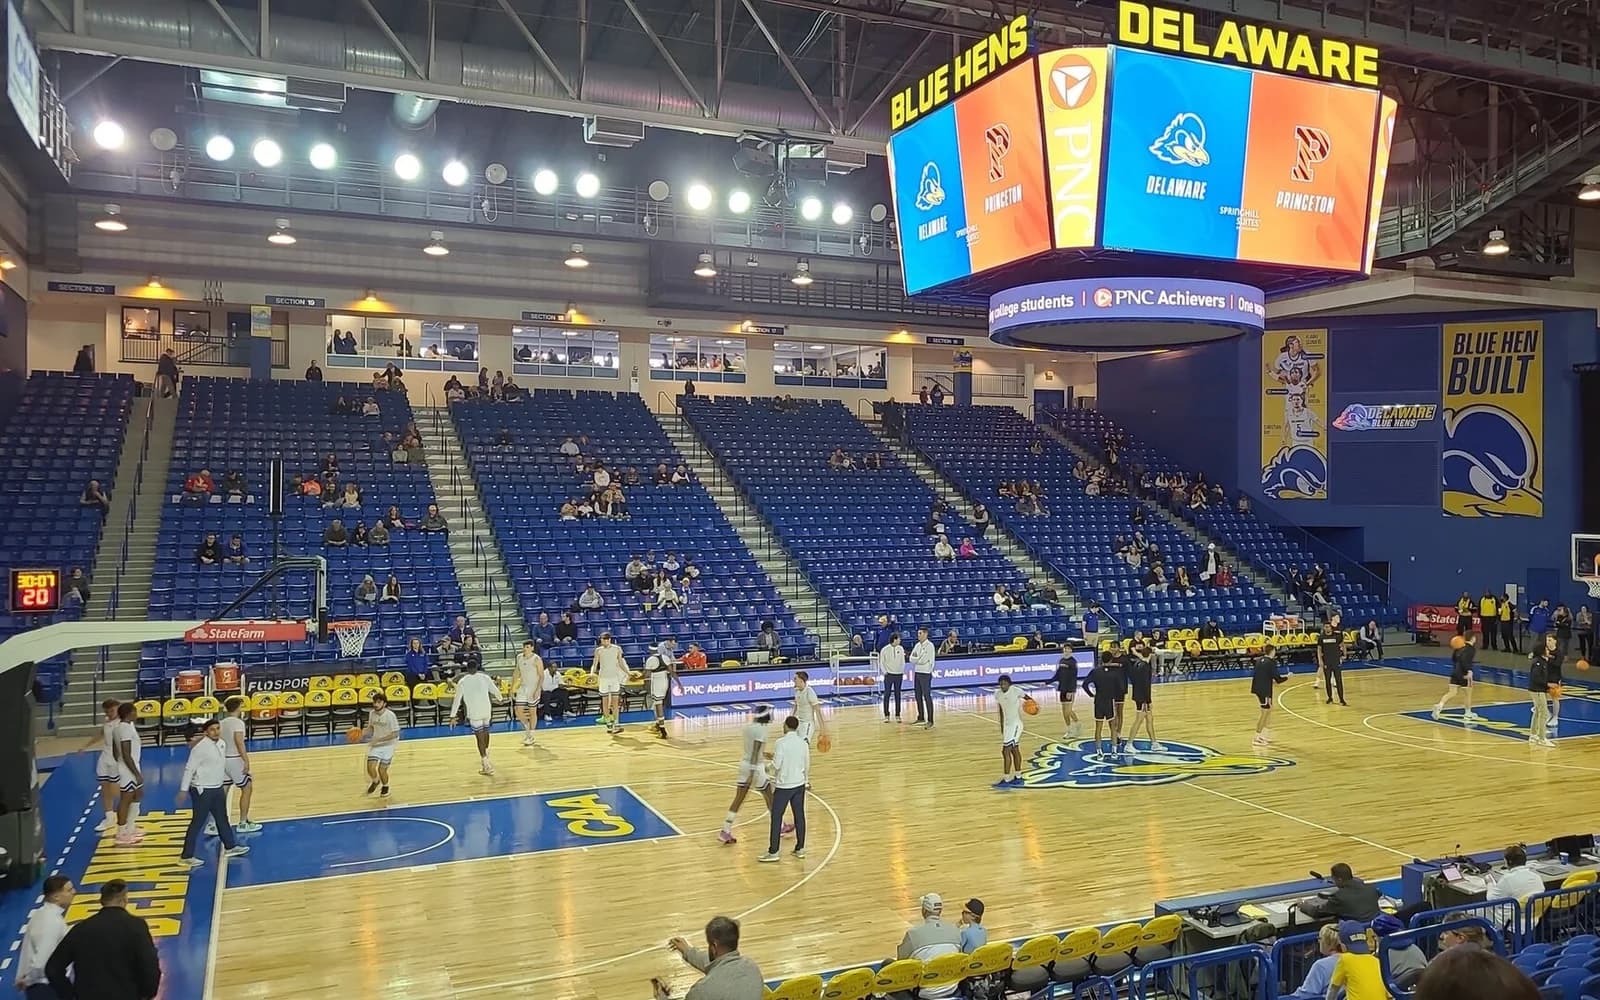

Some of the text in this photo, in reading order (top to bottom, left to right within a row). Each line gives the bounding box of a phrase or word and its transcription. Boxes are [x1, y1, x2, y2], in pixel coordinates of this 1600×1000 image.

[1119, 0, 1379, 85] DELAWARE
[891, 15, 1027, 130] BLUE HENS
[1054, 122, 1094, 240] PNC
[1146, 175, 1208, 200] DELAWARE
[984, 184, 1023, 215] PRINCETON
[1275, 191, 1336, 214] PRINCETON
[918, 215, 948, 241] DELAWARE
[59, 284, 92, 292] SECTION
[1114, 290, 1226, 308] PNC Achievers
[275, 297, 306, 305] SECTION
[994, 303, 1019, 319] college
[1021, 294, 1074, 312] students
[1238, 296, 1254, 313] One
[1453, 329, 1538, 355] BLUE HEN
[1447, 354, 1535, 395] BUILT
[1367, 405, 1434, 419] DELAWARE
[1371, 419, 1415, 427] BLUE HENS
[23, 588, 49, 605] 20
[247, 677, 309, 692] FLOSPOR
[931, 669, 942, 678] NC
[944, 667, 978, 677] Achievers
[683, 685, 704, 695] PNC
[707, 683, 746, 693] Achievers
[545, 793, 635, 837] CAA
[64, 808, 194, 936] ELAWARE
